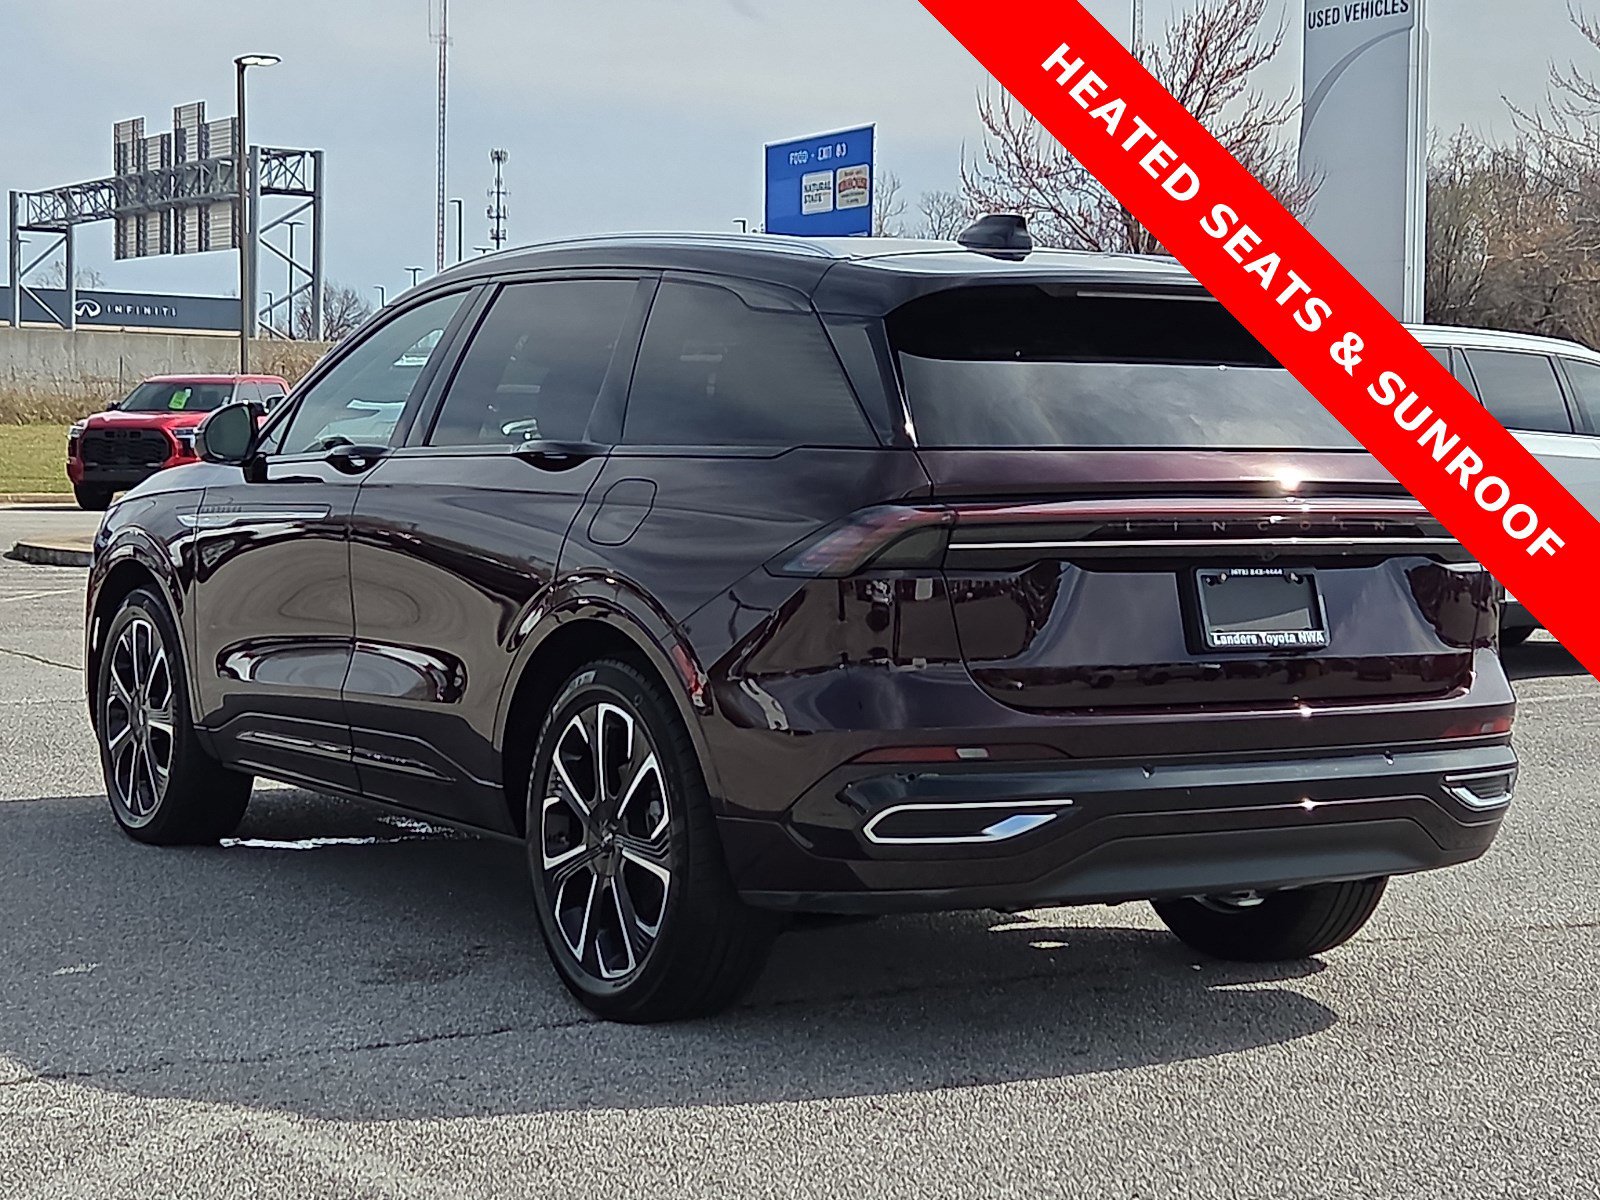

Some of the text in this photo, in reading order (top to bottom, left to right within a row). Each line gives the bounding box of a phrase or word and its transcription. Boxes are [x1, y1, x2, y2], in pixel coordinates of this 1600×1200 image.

[1307, 0, 1409, 30] USED VEHICLES
[106, 304, 178, 318] INFINITI
[1125, 520, 1386, 532] LINCOLN
[1213, 630, 1325, 647] Landers Toyota NWA
